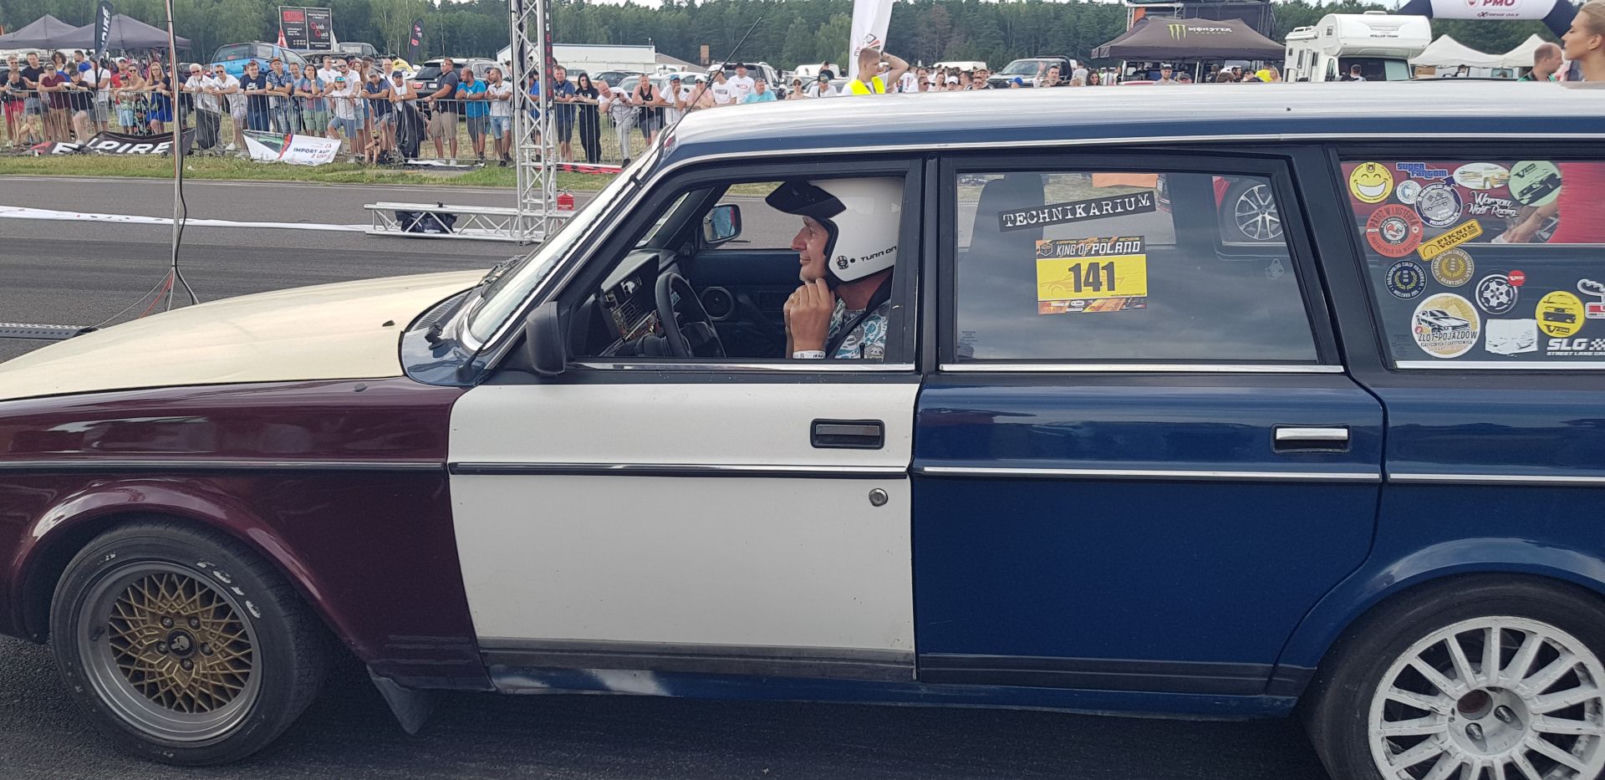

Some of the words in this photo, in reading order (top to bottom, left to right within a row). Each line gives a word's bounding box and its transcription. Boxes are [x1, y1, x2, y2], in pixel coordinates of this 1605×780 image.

[1002, 193, 1151, 227] TECHNIKARIUM
[1437, 222, 1476, 245] PIKNIK
[1439, 232, 1468, 249] VOLVO
[1056, 244, 1075, 257] KING
[1078, 244, 1091, 255] OF
[1091, 241, 1141, 255] POLAND
[1068, 261, 1116, 293] 141
[1547, 338, 1588, 350] SLG
